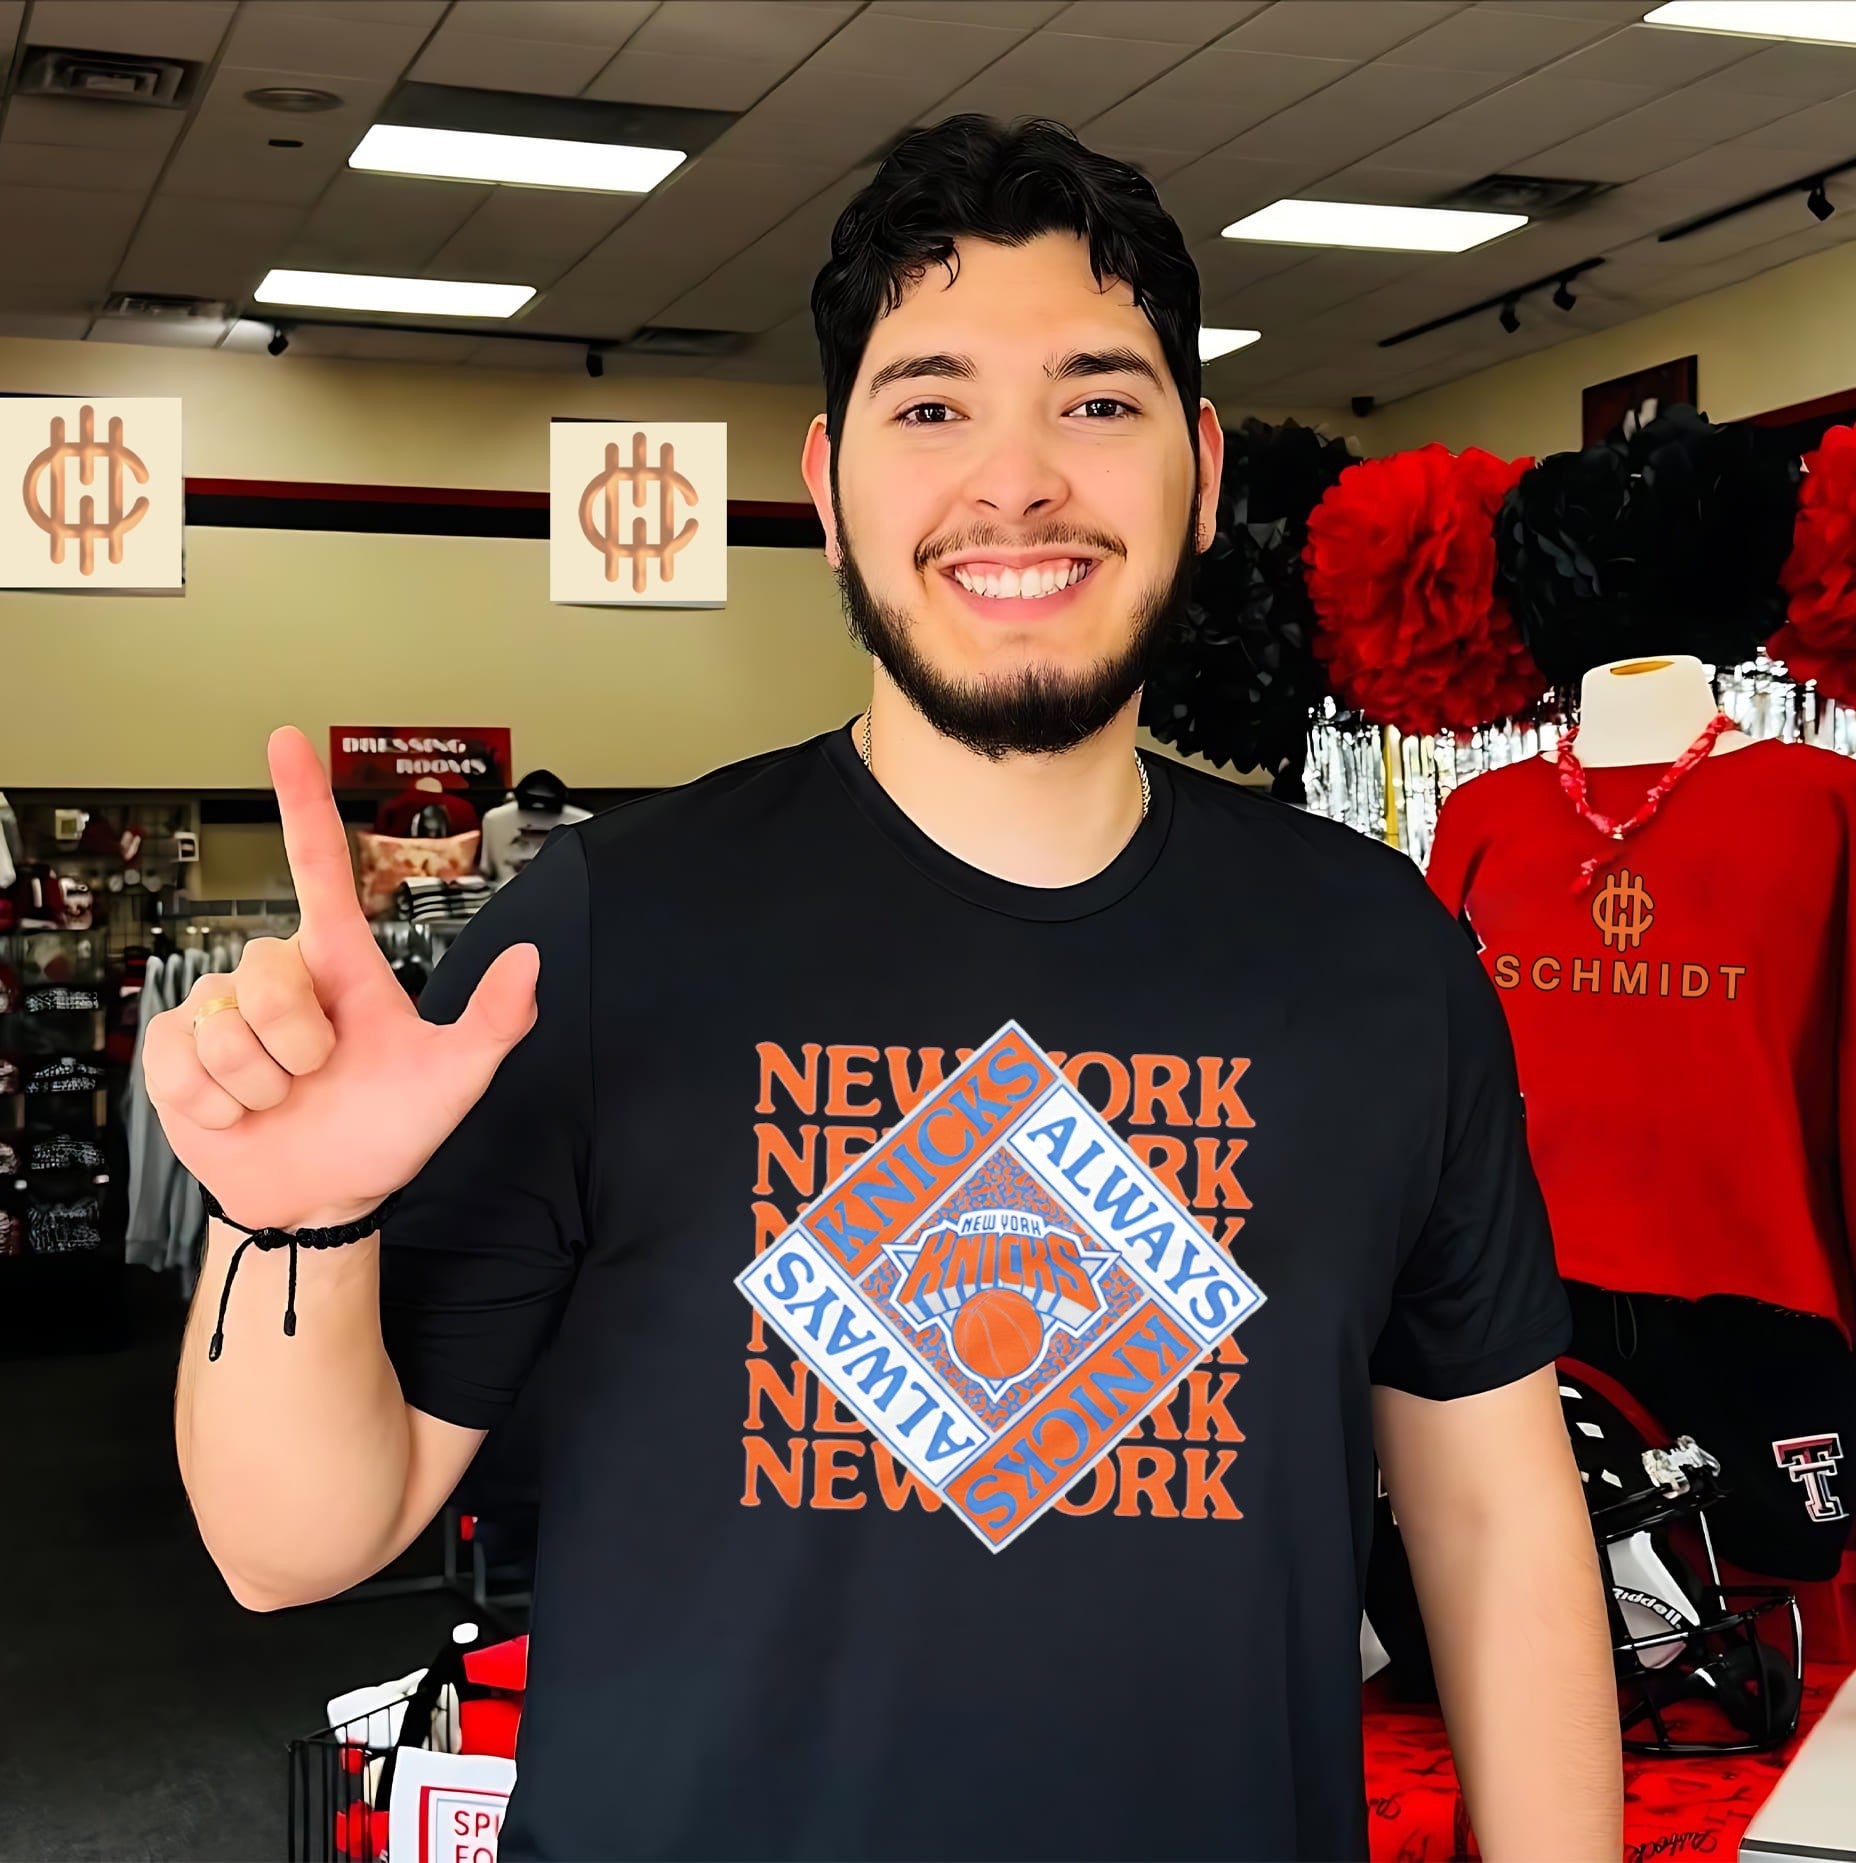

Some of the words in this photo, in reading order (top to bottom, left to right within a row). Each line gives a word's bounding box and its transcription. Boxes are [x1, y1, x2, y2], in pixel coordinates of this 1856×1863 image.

[1494, 954, 1746, 1000] SCHMIDT
[815, 1047, 1040, 1263] KNICKS
[1046, 1051, 1256, 1128] ORK
[897, 1231, 1101, 1314] KNICKS
[961, 1214, 997, 1233] NEW
[1000, 1215, 1042, 1236] YORK
[1027, 1116, 1241, 1329] ALWAYS
[763, 1250, 976, 1462] ALWAYS
[964, 1313, 1191, 1530] KNICKS
